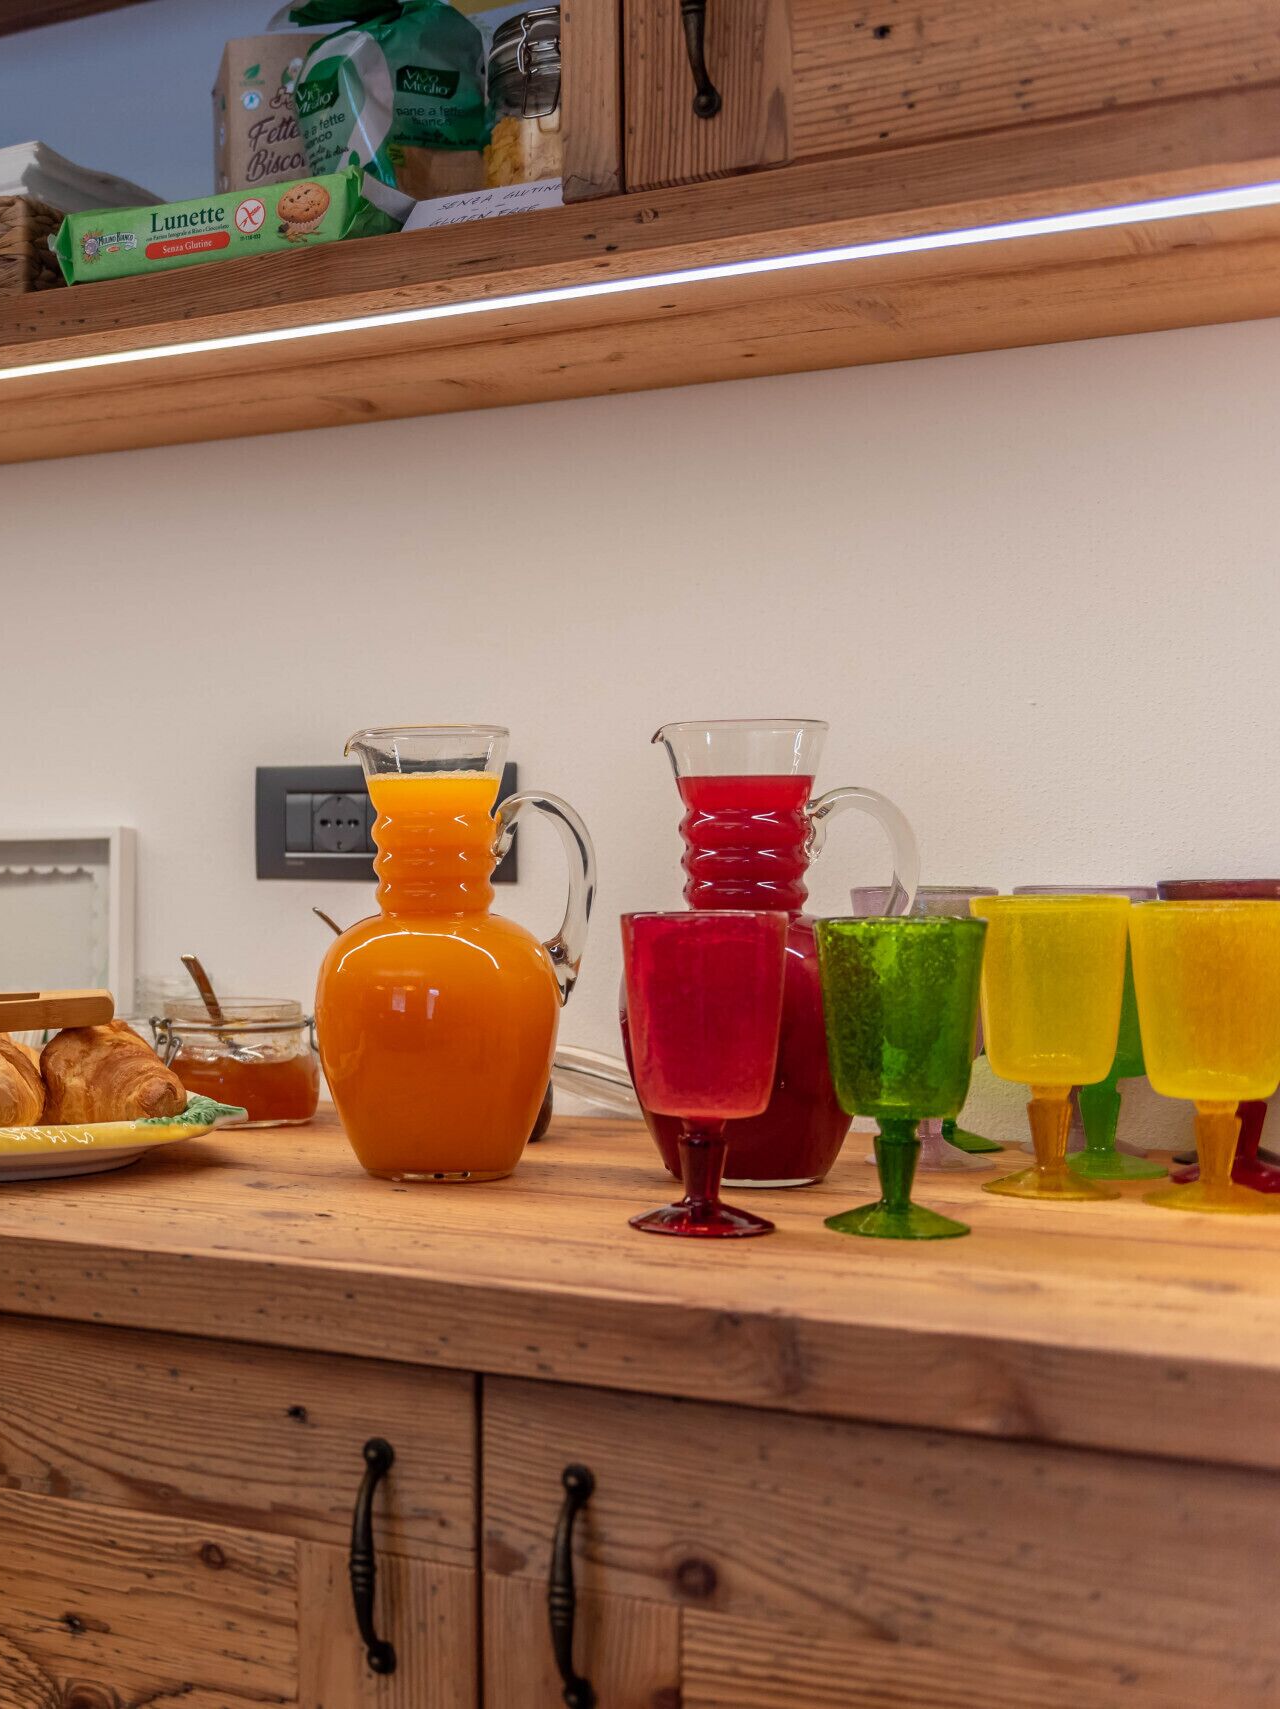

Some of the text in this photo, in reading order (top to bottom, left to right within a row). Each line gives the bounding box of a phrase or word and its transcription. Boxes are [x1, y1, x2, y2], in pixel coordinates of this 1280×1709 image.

[428, 107, 437, 116] a
[319, 113, 345, 130] fette
[150, 207, 225, 233] Lunette
[162, 240, 213, 254] Senza Glutine
